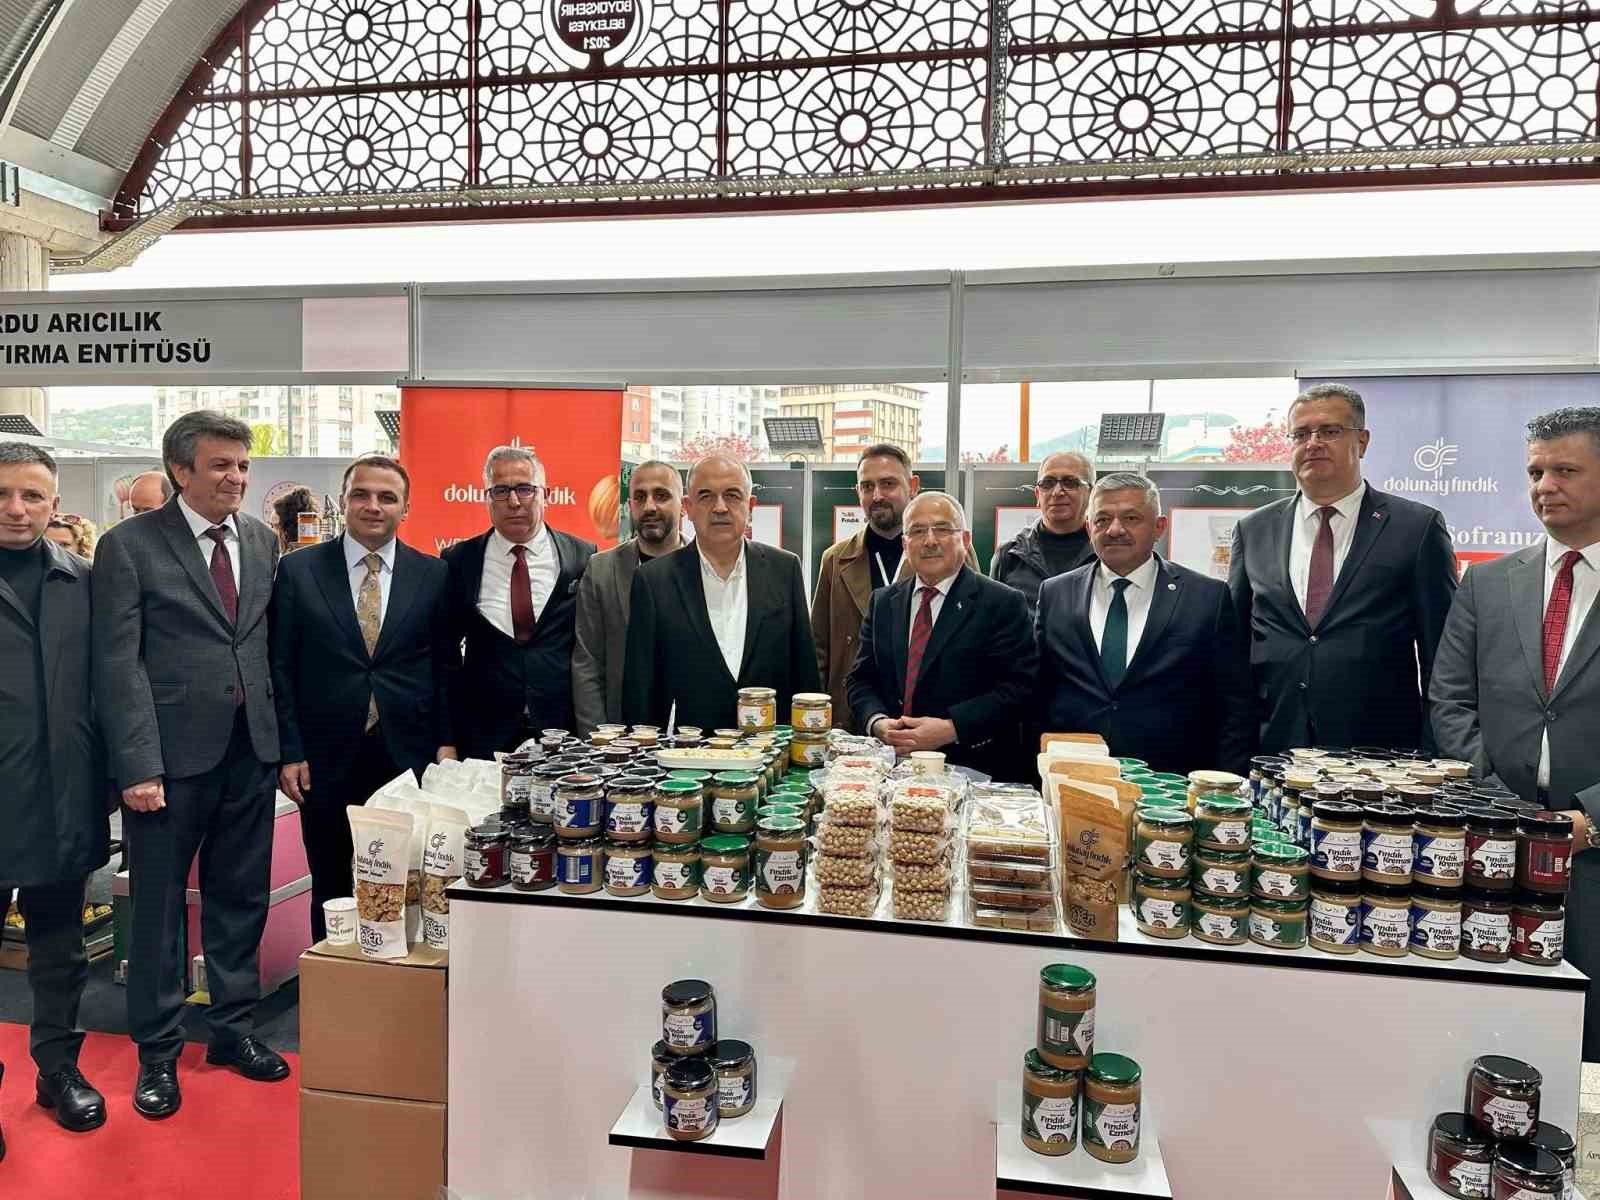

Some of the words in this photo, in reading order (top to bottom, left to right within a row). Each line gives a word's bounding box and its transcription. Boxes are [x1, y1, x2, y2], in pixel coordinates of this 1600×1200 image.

[0, 313, 38, 333] DU
[48, 311, 161, 332] ARICILIK
[78, 338, 211, 364] ENTİTÜSÜ
[1384, 476, 1448, 496] dolunay
[1450, 476, 1498, 493] fındık
[1041, 1115, 1065, 1125] Fındık
[1103, 1121, 1129, 1131] Fındık
